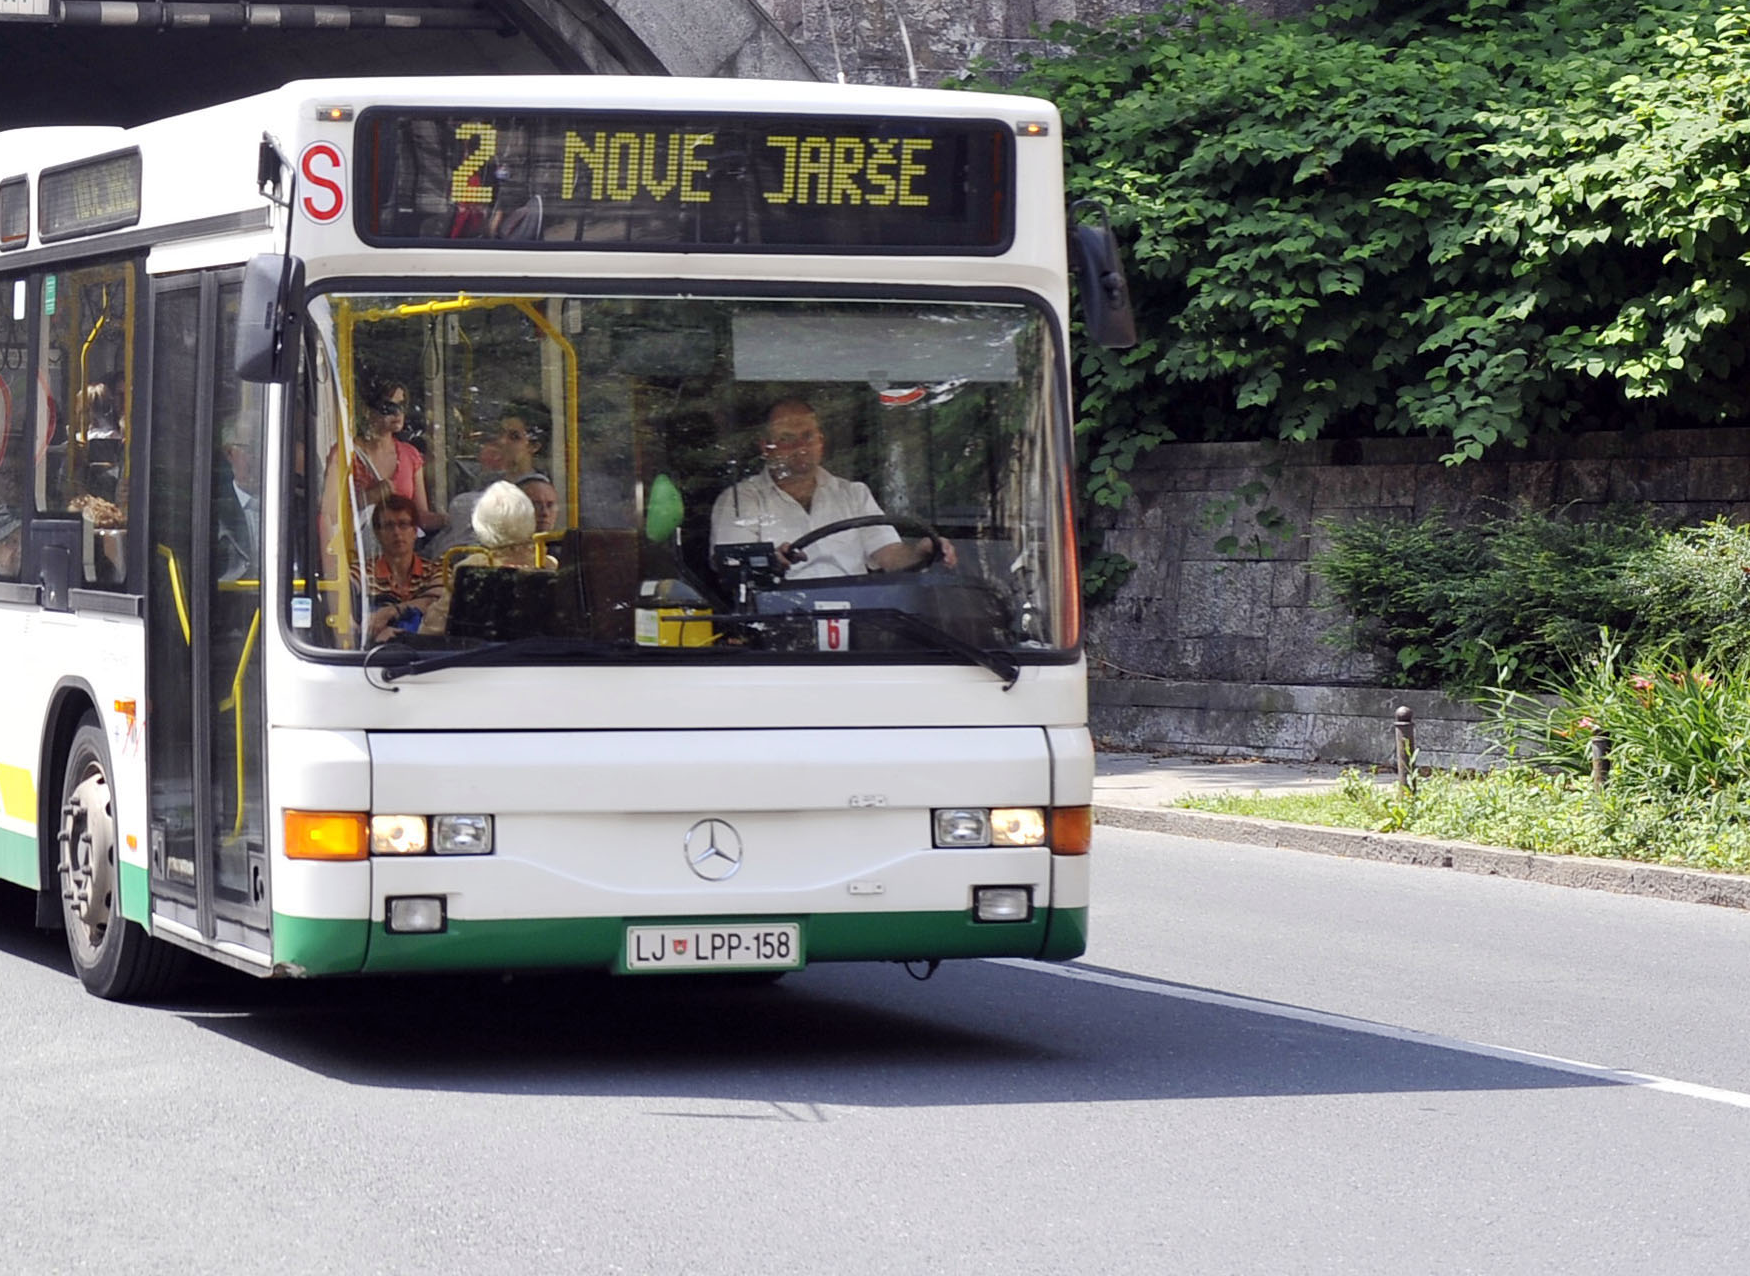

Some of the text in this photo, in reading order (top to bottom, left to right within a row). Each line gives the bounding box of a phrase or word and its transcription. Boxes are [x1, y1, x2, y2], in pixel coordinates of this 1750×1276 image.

[301, 144, 343, 221] S
[451, 122, 933, 206] 2 NOVE JARŠE
[636, 931, 791, 961] LJ LPP-158
